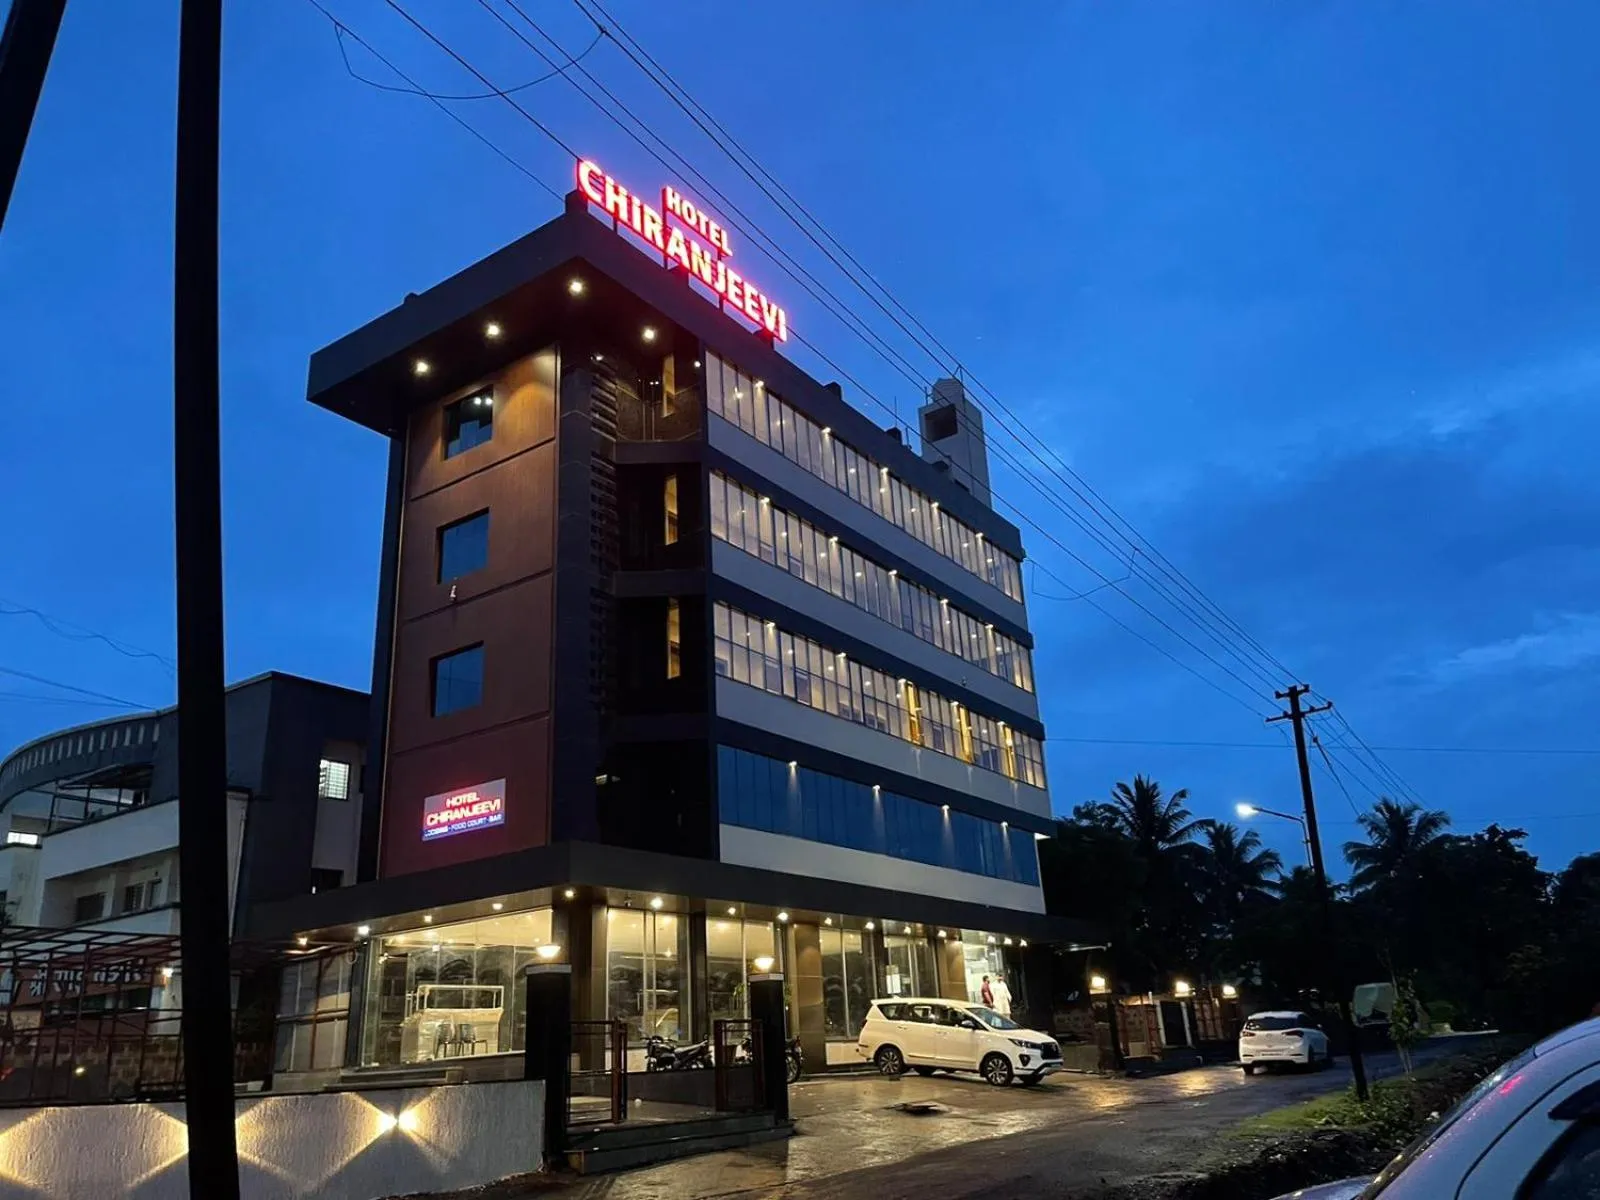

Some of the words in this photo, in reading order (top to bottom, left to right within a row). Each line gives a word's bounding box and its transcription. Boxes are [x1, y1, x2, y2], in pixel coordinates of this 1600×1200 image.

[664, 185, 733, 257] HOTEL
[577, 158, 788, 342] CHIRANJEEVI
[426, 799, 501, 826] CHIRANJEEVI
[446, 792, 480, 808] HOTEL
